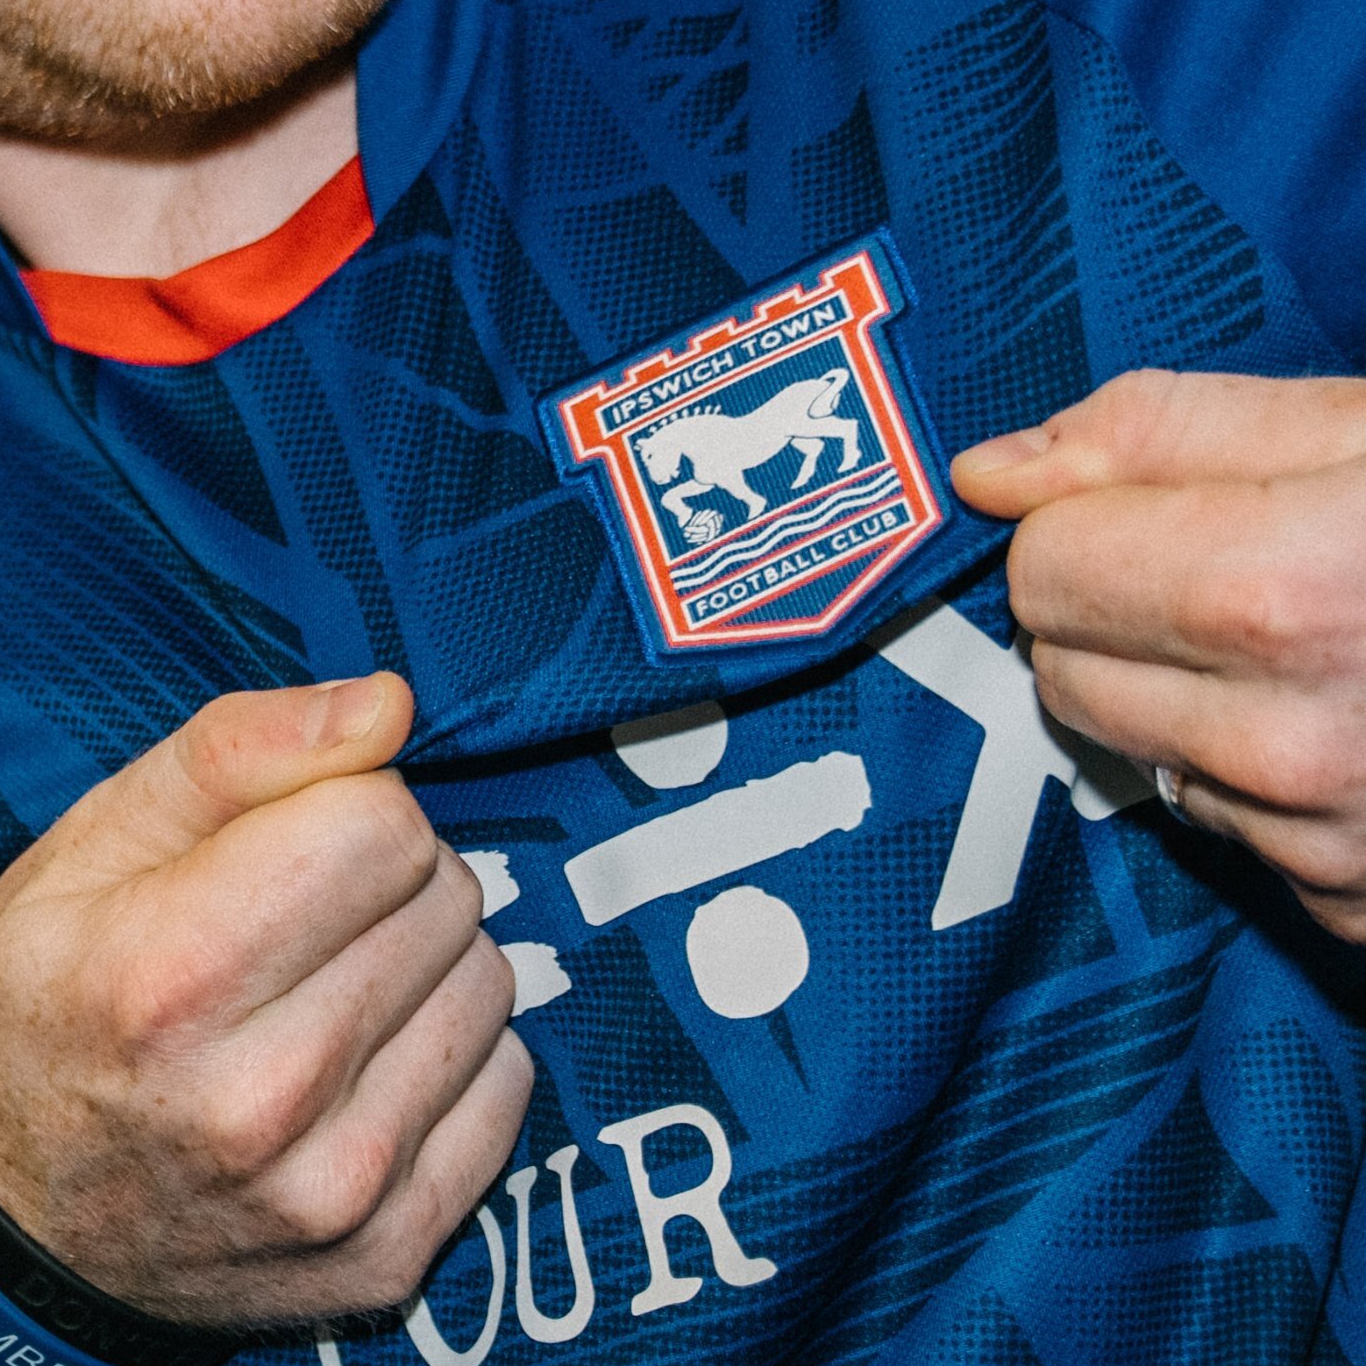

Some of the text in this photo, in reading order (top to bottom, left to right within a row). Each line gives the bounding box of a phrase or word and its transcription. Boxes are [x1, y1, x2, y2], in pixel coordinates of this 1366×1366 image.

[610, 304, 836, 426] IPSWICH TOWN
[695, 511, 898, 618] FOOTBALL CLUB
